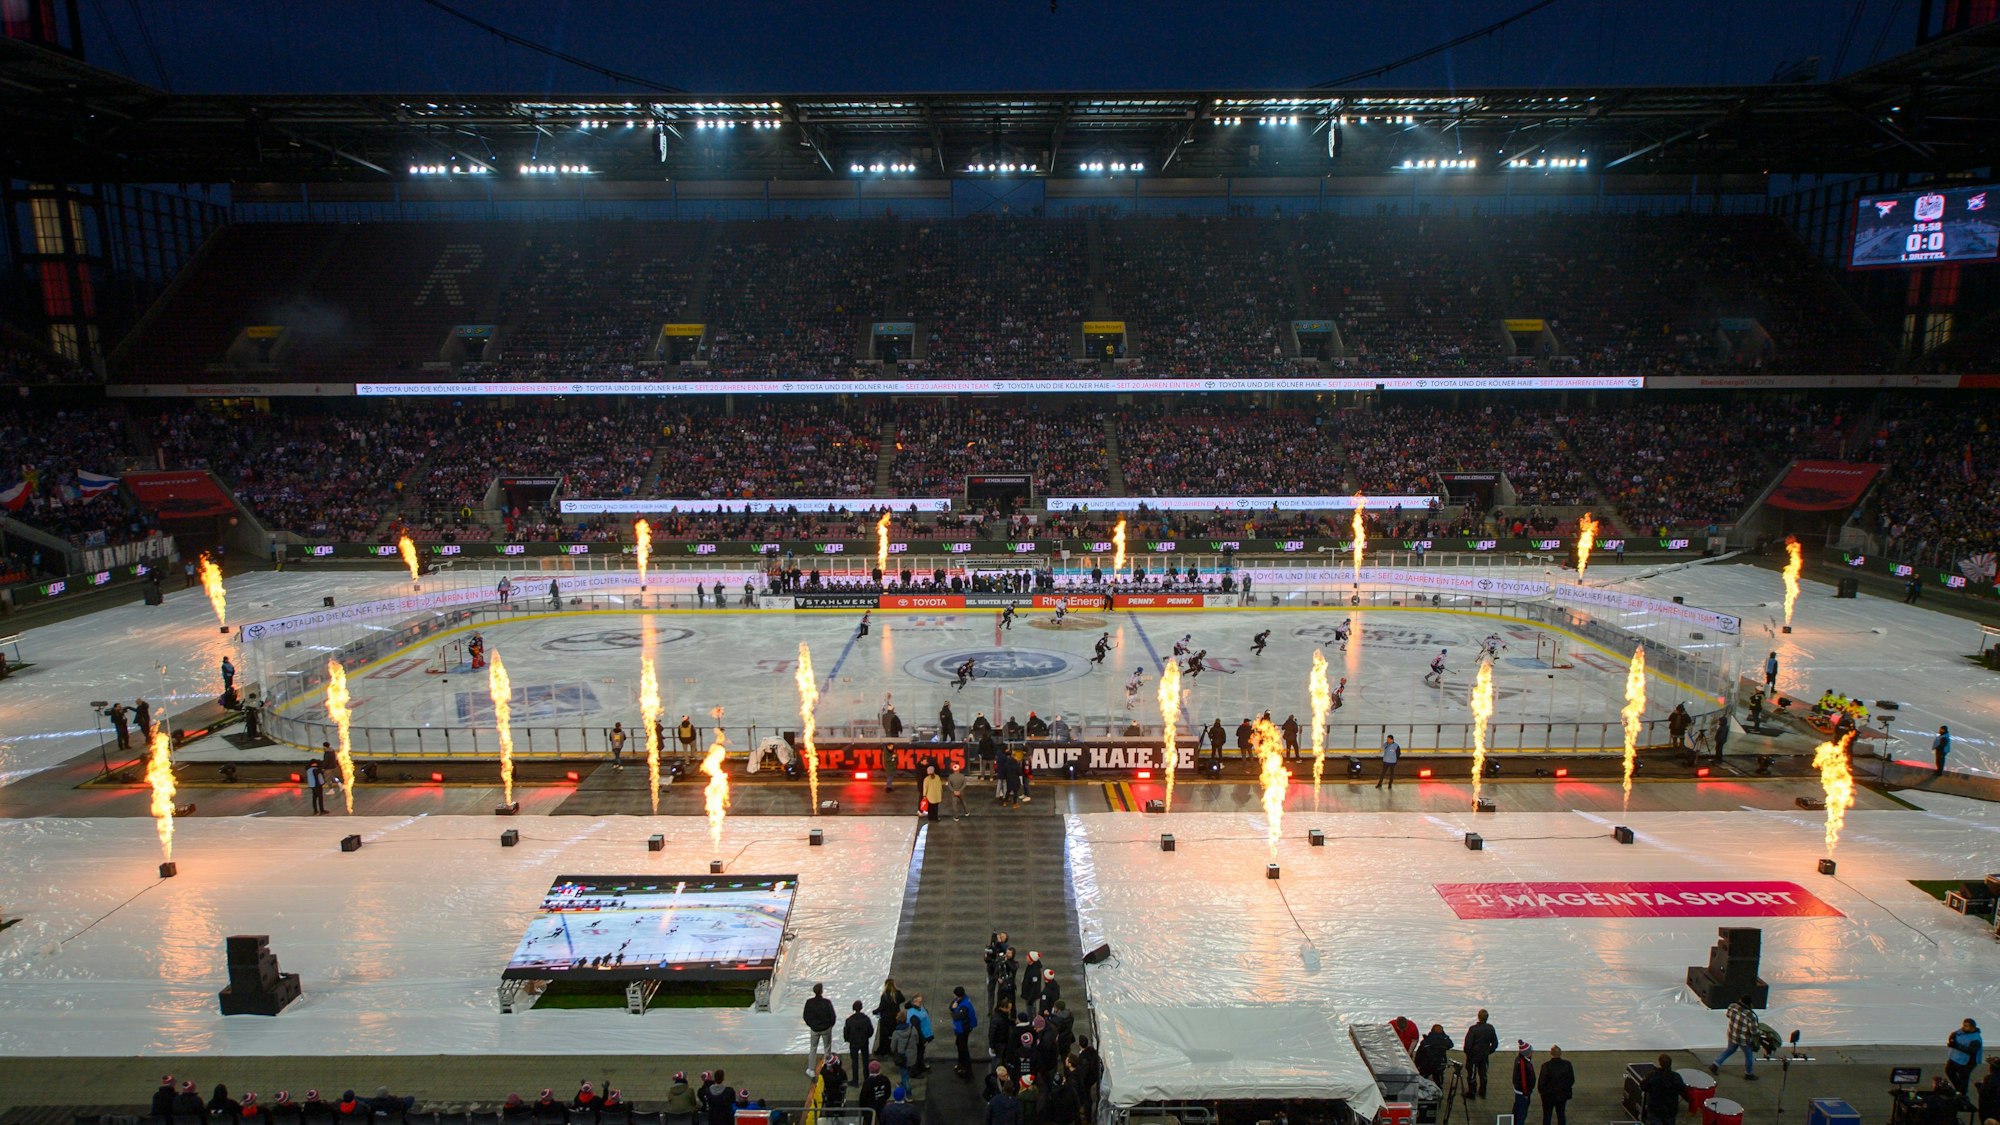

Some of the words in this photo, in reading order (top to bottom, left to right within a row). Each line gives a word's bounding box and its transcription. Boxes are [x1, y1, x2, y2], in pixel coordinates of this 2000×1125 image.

[1906, 232, 1945, 252] 0:0
[1496, 582, 1530, 591] TOYOTA
[1501, 892, 1678, 908] MAGENTA
[1680, 892, 1802, 906] SPORT
